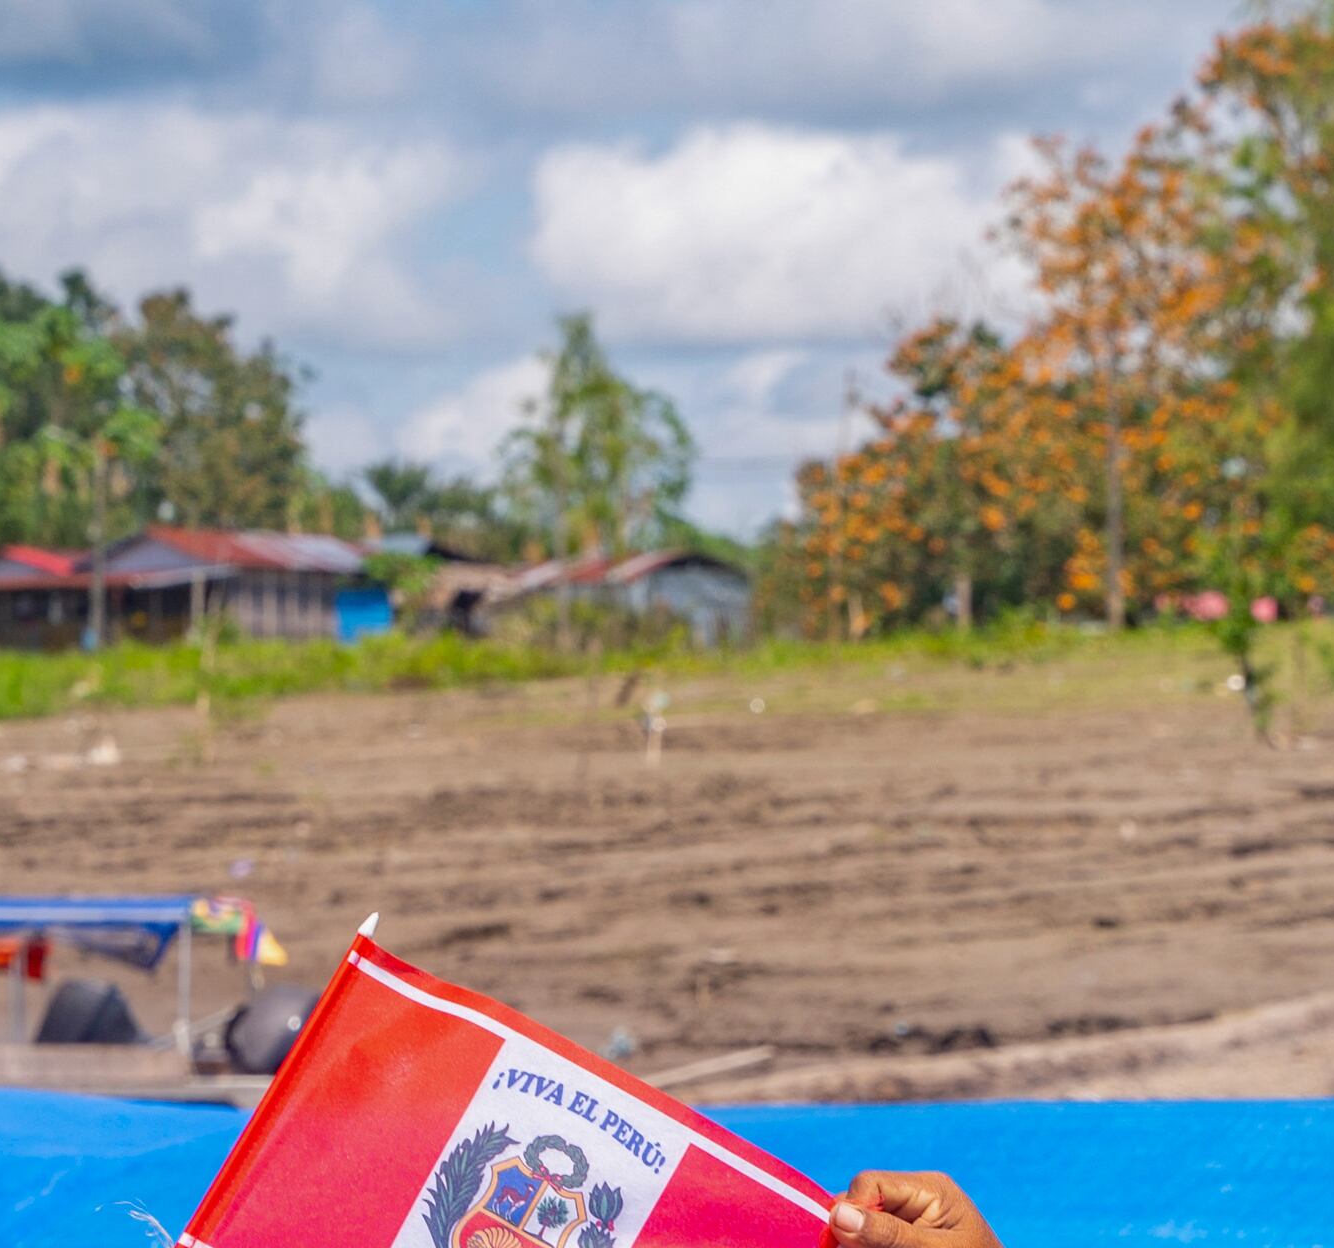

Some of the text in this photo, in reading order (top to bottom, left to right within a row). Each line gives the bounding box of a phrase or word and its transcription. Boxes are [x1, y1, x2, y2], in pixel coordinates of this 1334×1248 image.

[492, 1069, 667, 1175] ¡VIVA EL PERÚ!
